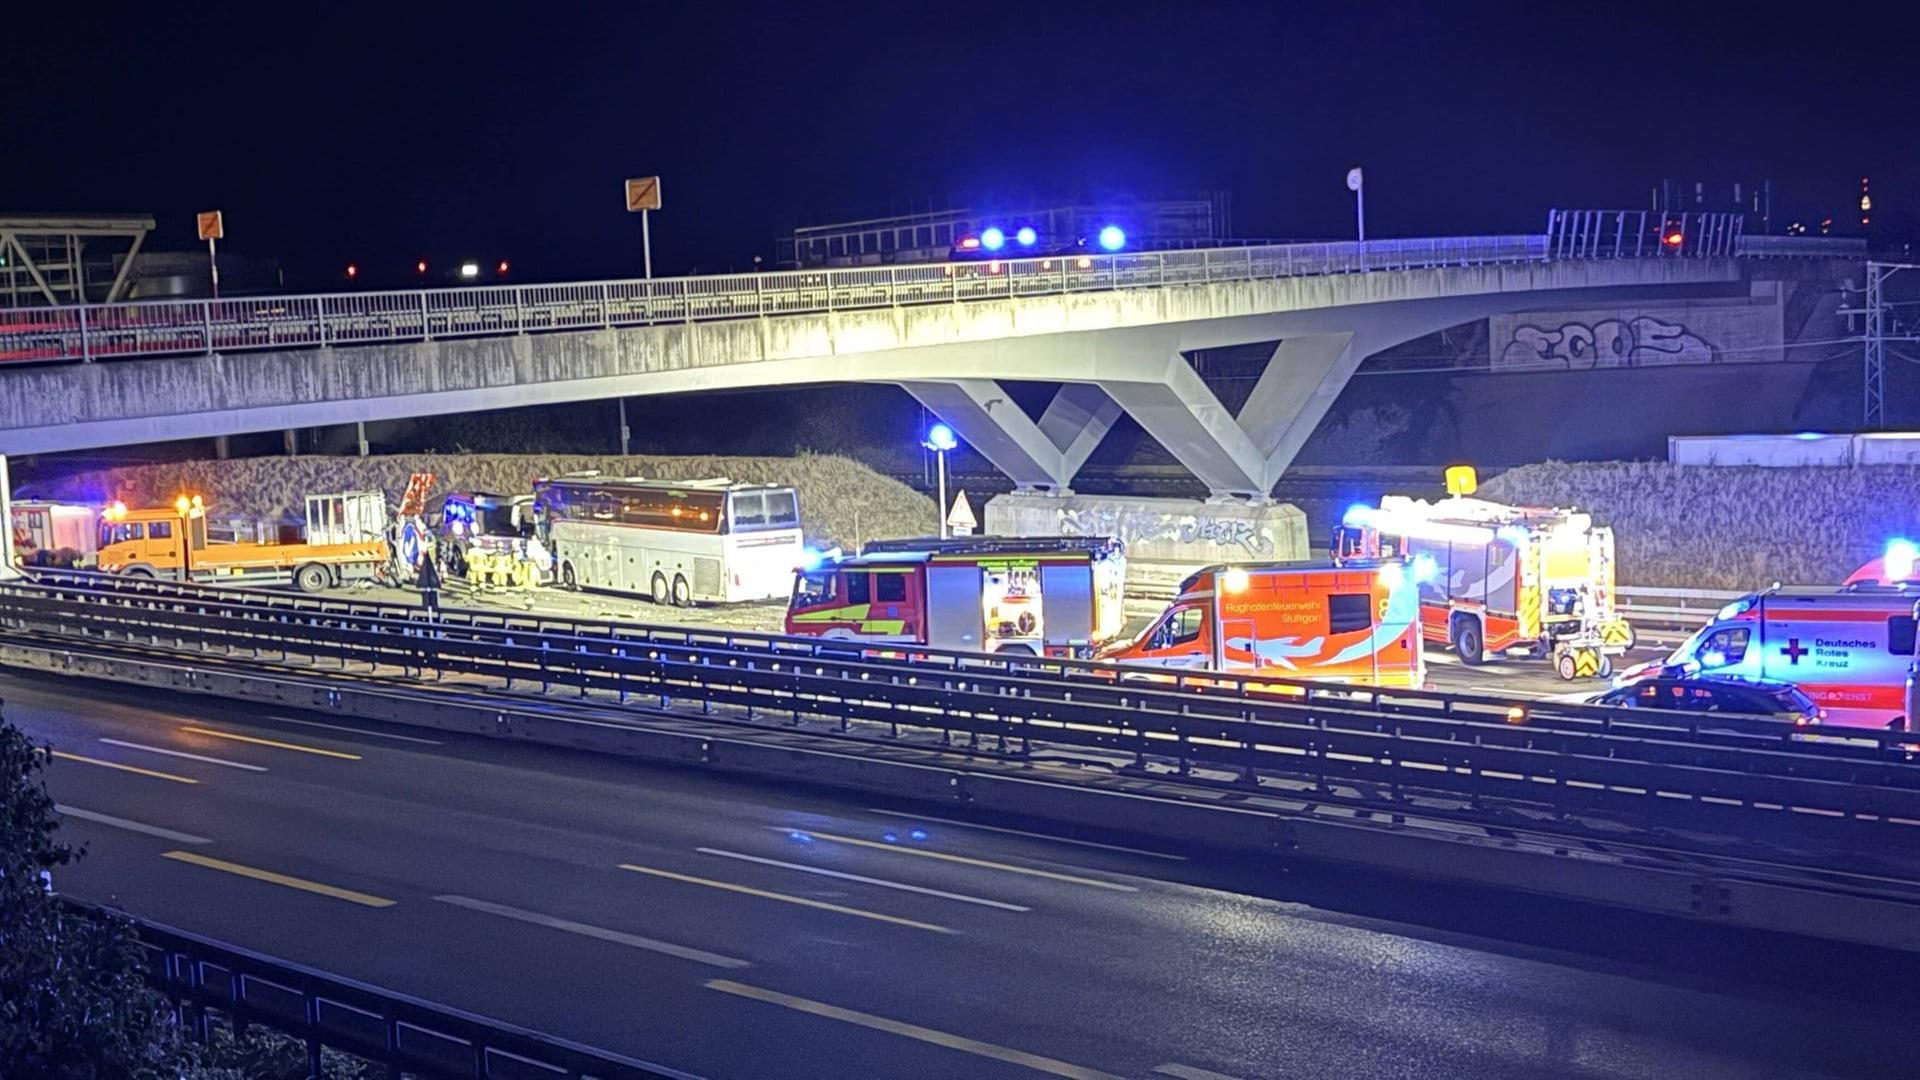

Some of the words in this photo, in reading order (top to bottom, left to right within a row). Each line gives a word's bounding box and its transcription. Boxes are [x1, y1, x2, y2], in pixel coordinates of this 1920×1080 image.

[1225, 601, 1321, 613] Flughafenfeuerwehr
[1282, 613, 1321, 624] Stuttgart
[1815, 638, 1876, 648] Deutsches
[1816, 648, 1849, 657] Rotes
[1816, 659, 1848, 668] Kreuz
